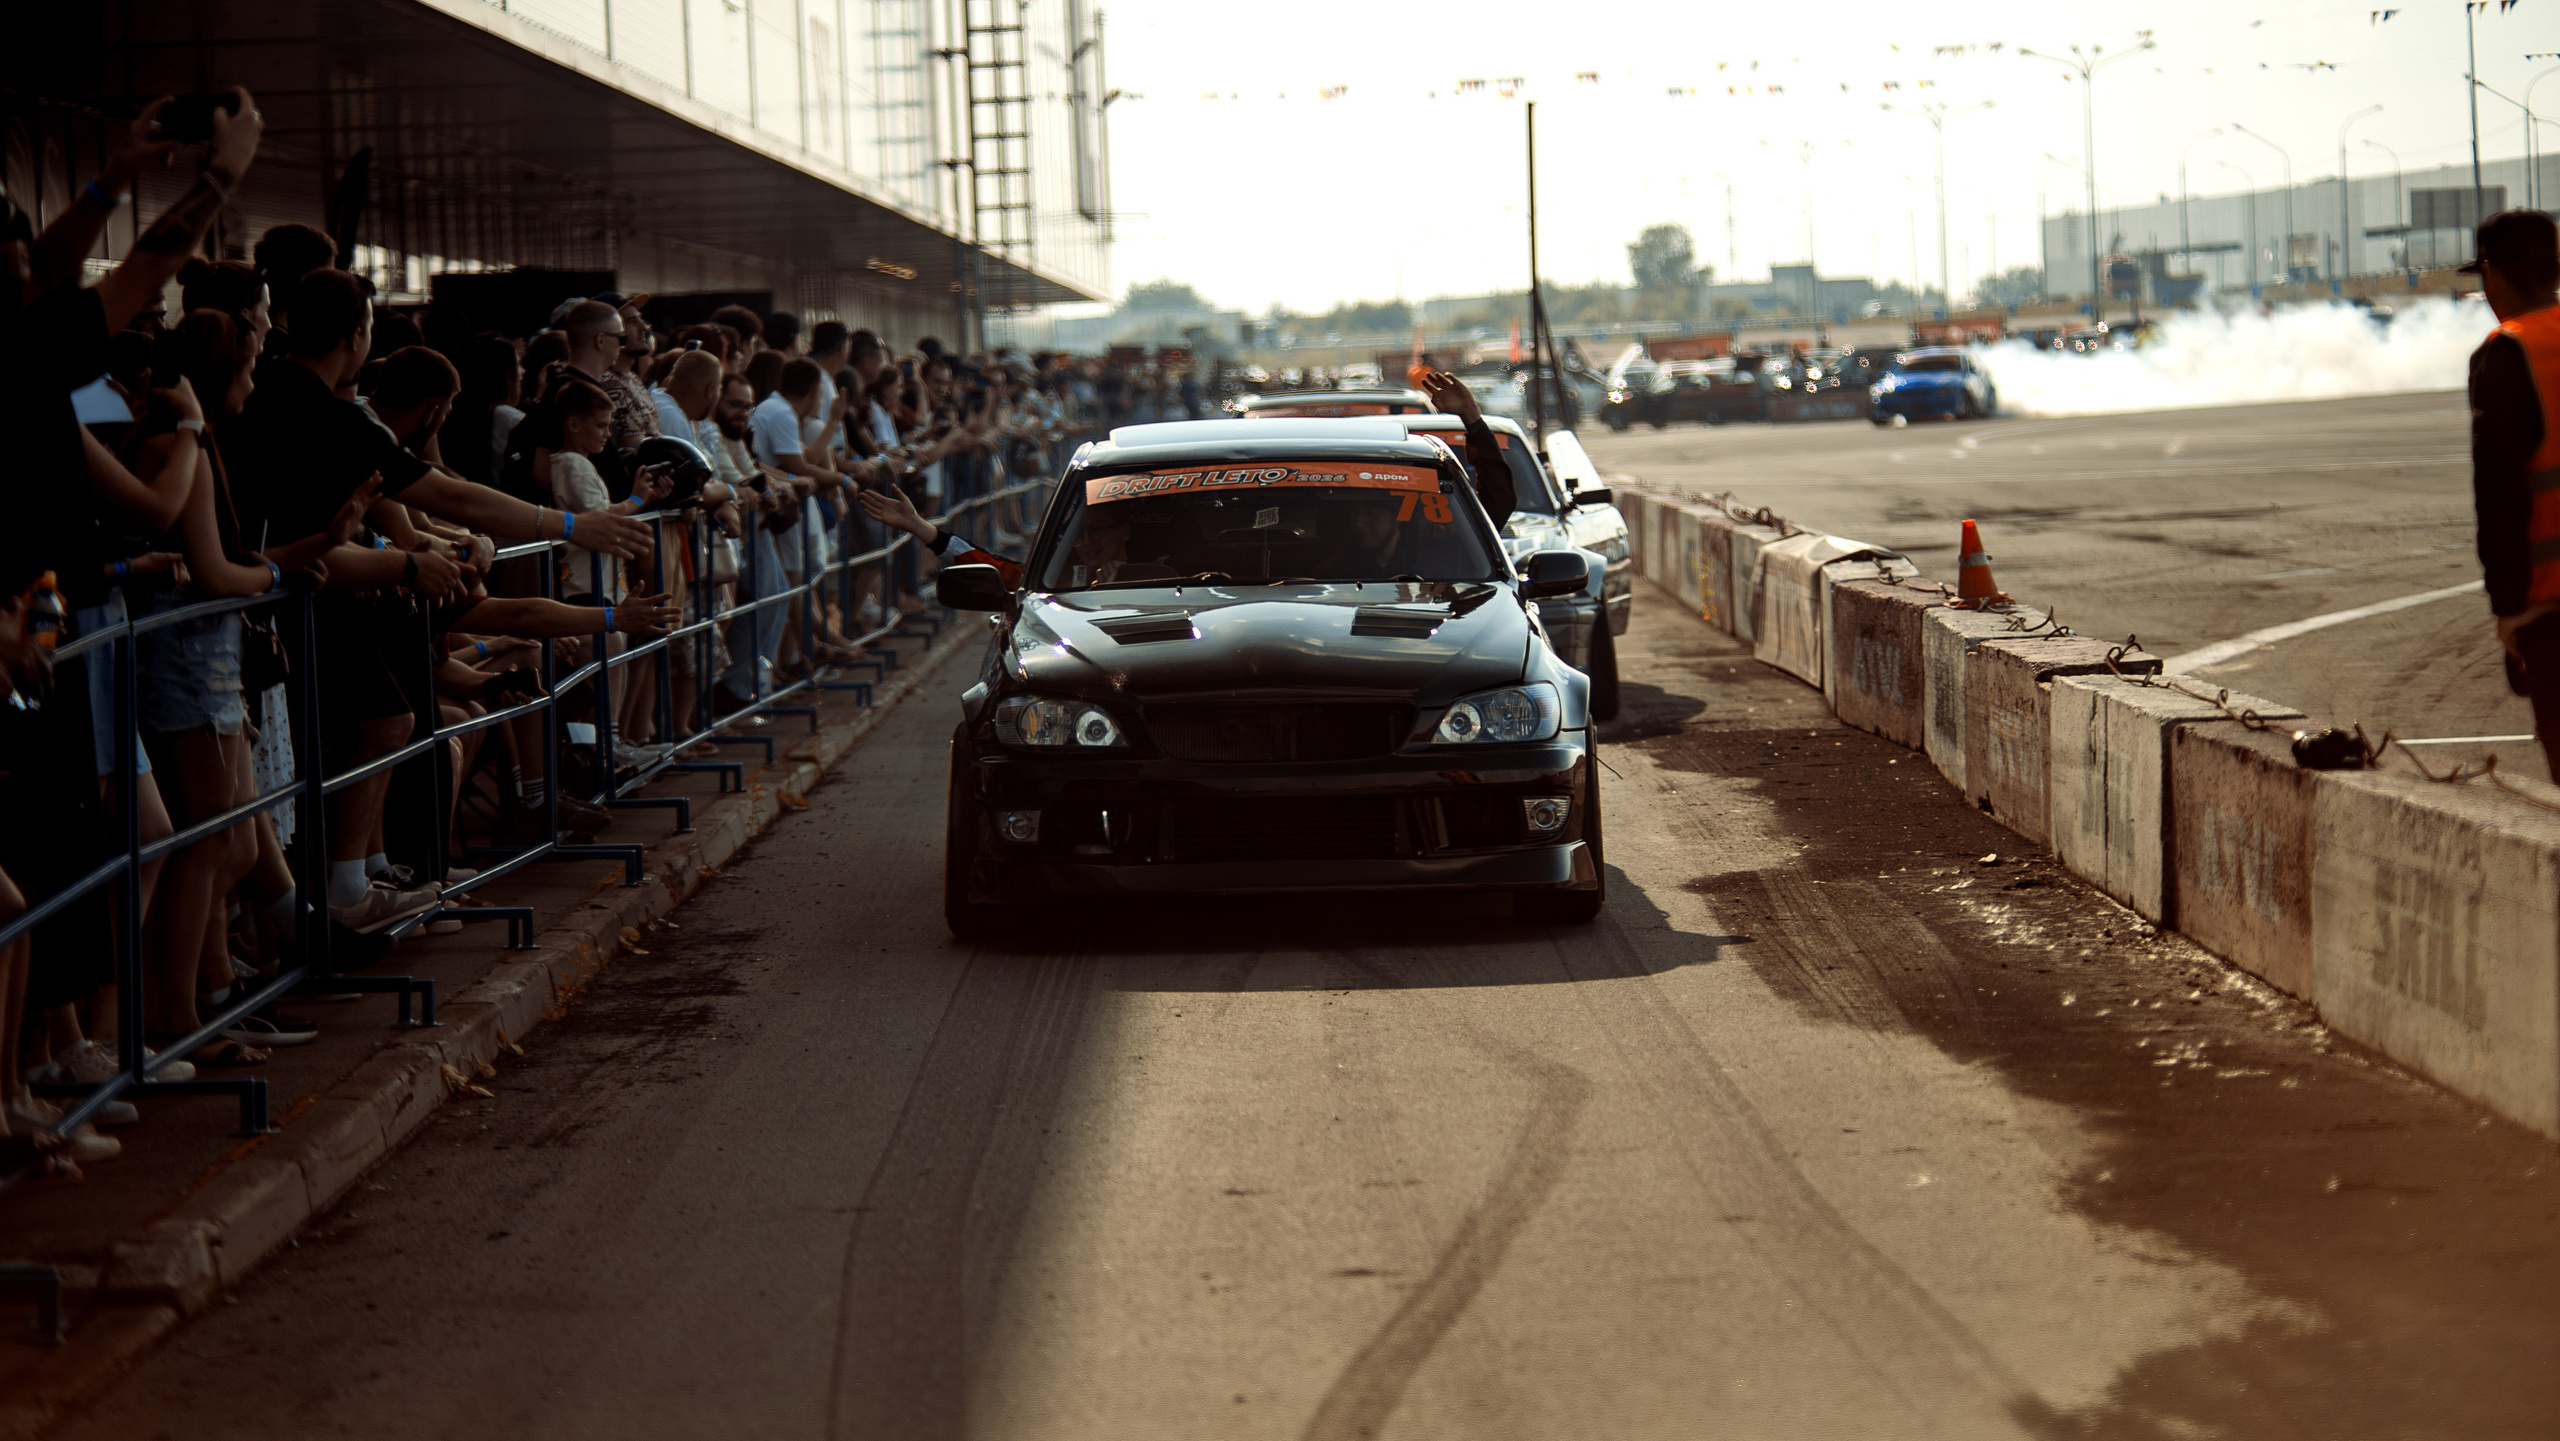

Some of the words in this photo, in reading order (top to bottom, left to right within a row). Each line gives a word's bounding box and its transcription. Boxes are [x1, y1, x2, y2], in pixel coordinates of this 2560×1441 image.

[1099, 473, 1202, 498] DRIFT
[1203, 468, 1288, 485] LETO
[1296, 473, 1347, 482] 2026
[1374, 473, 1409, 481] дром
[1389, 491, 1453, 523] 78
